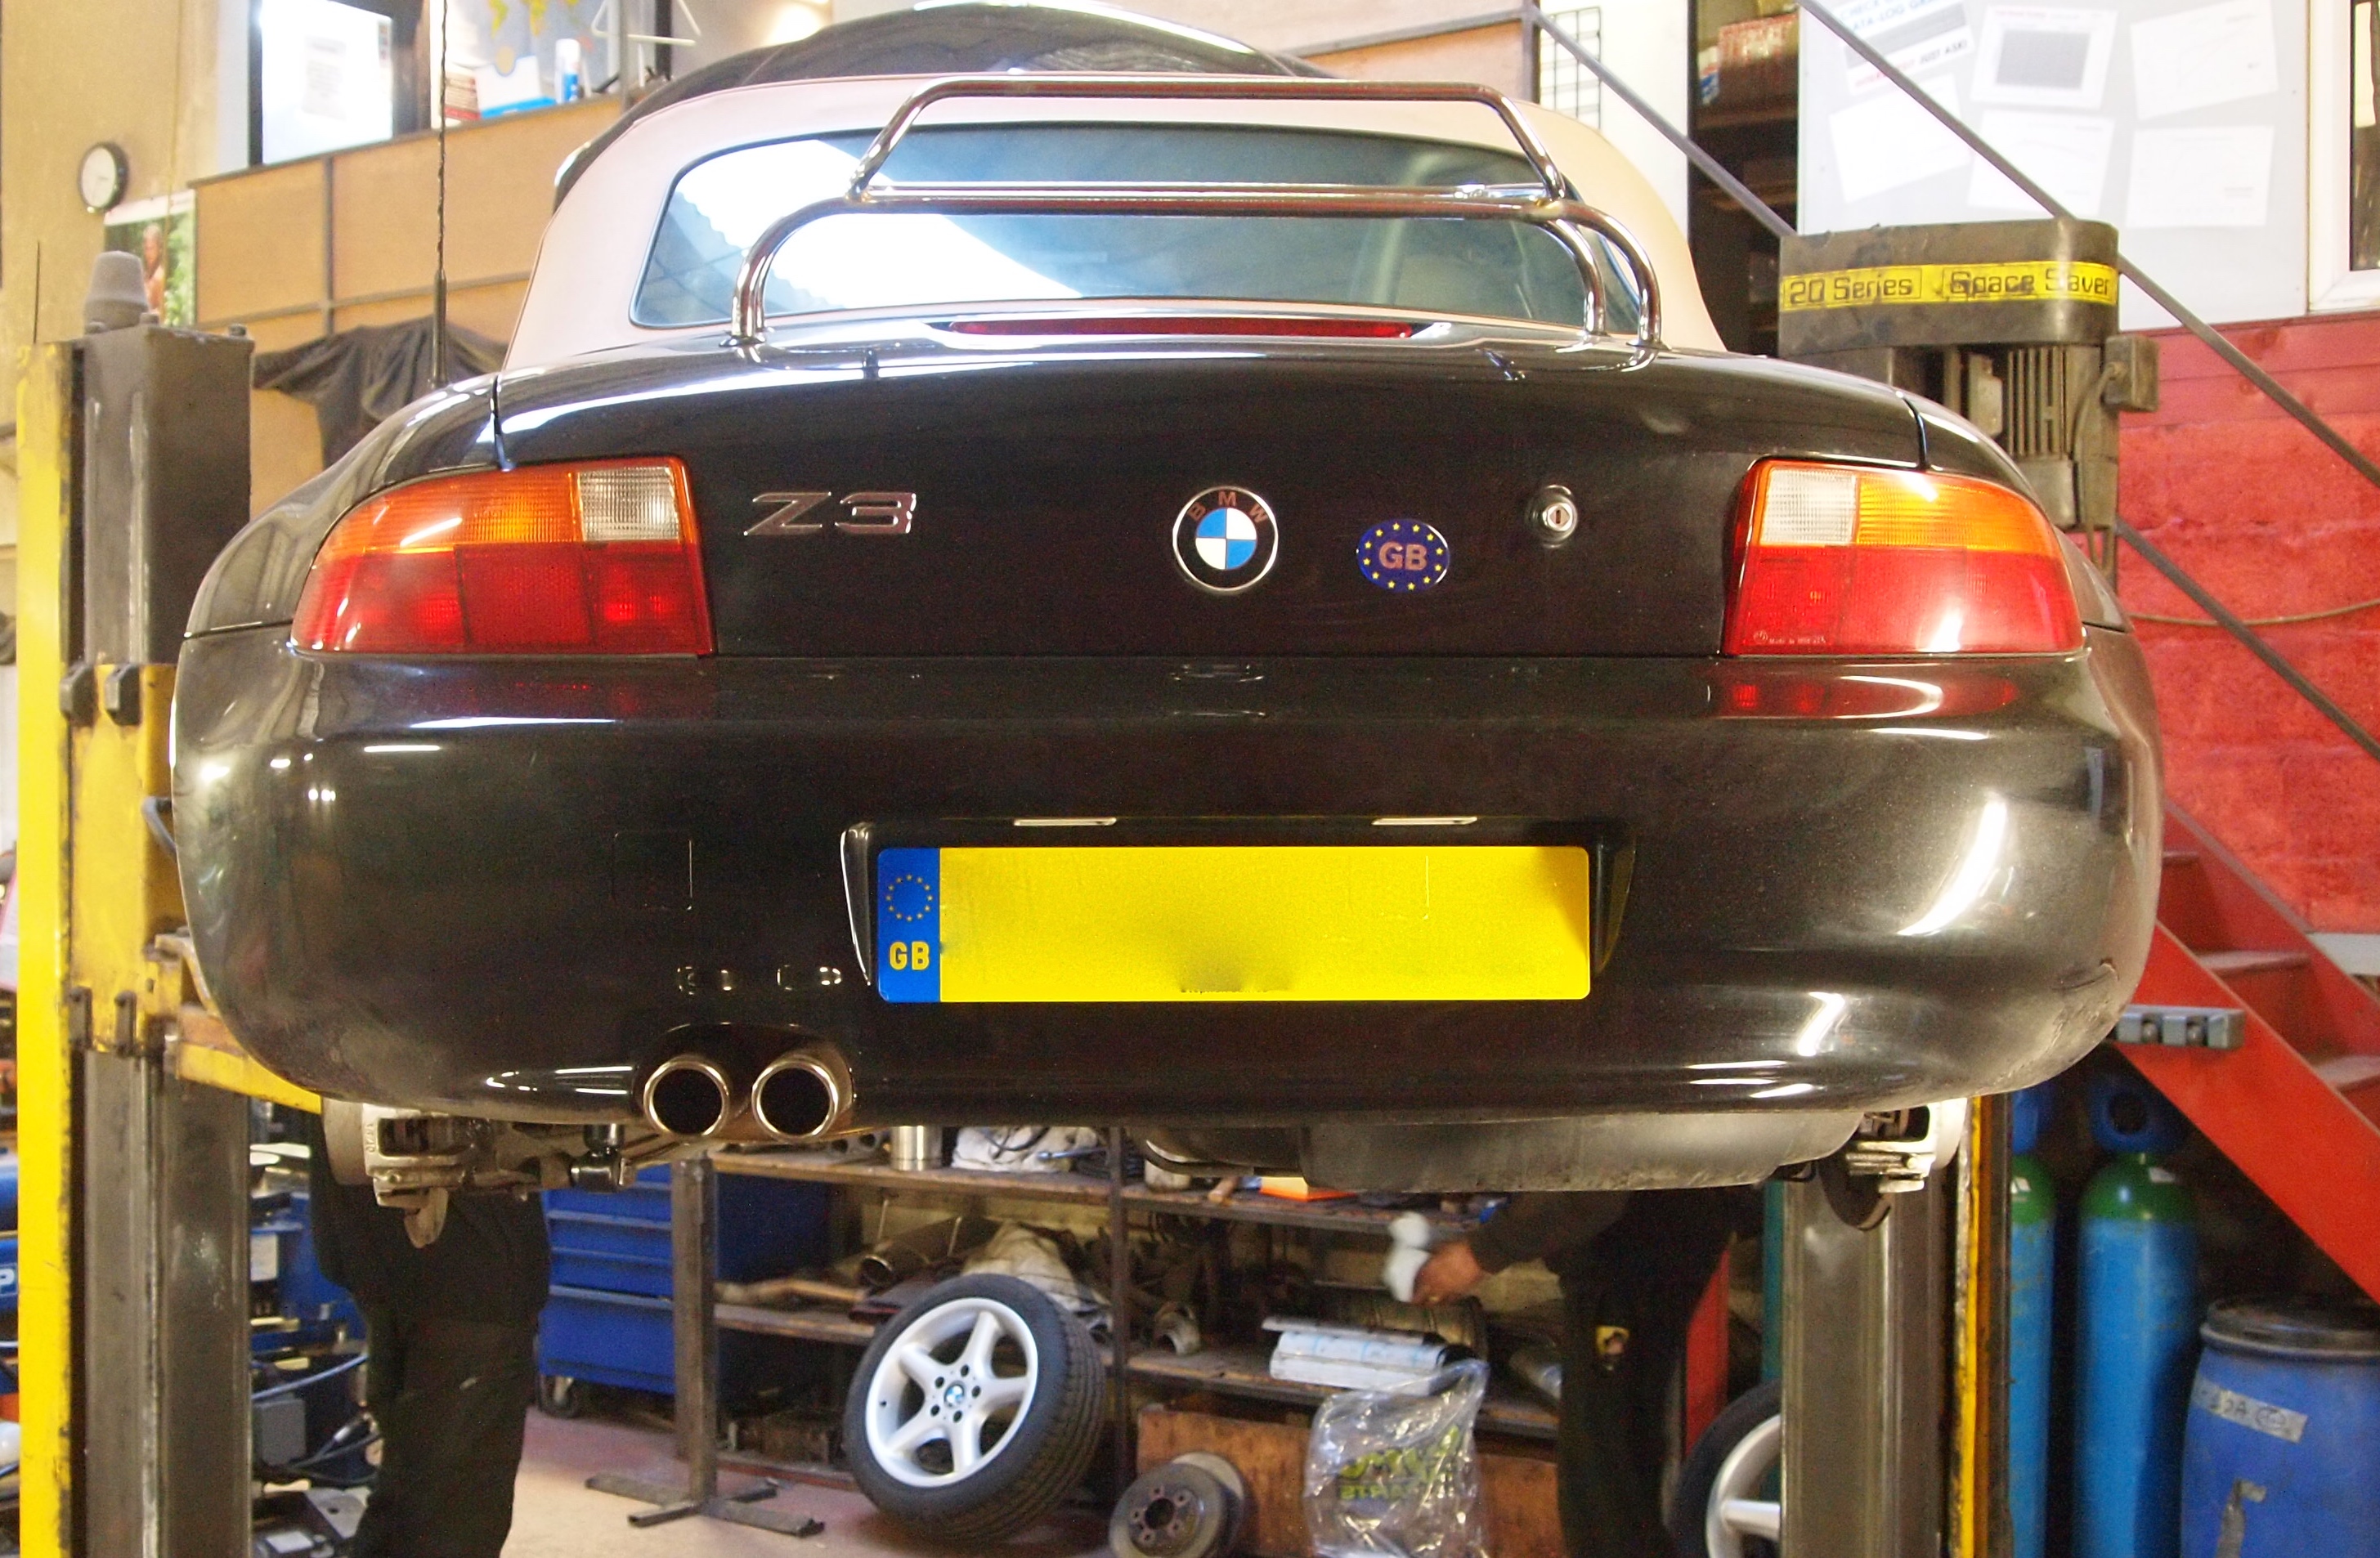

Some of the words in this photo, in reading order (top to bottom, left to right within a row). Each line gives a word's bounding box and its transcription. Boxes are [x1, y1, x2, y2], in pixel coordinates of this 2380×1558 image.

[1790, 279, 1825, 304] 20
[1834, 274, 1912, 300] Series
[1950, 271, 2035, 297] Space
[2046, 267, 2109, 295] Saver
[743, 492, 917, 535] Z3
[1186, 490, 1268, 523] BMW
[1378, 541, 1428, 571] GB
[890, 941, 930, 971] GB
